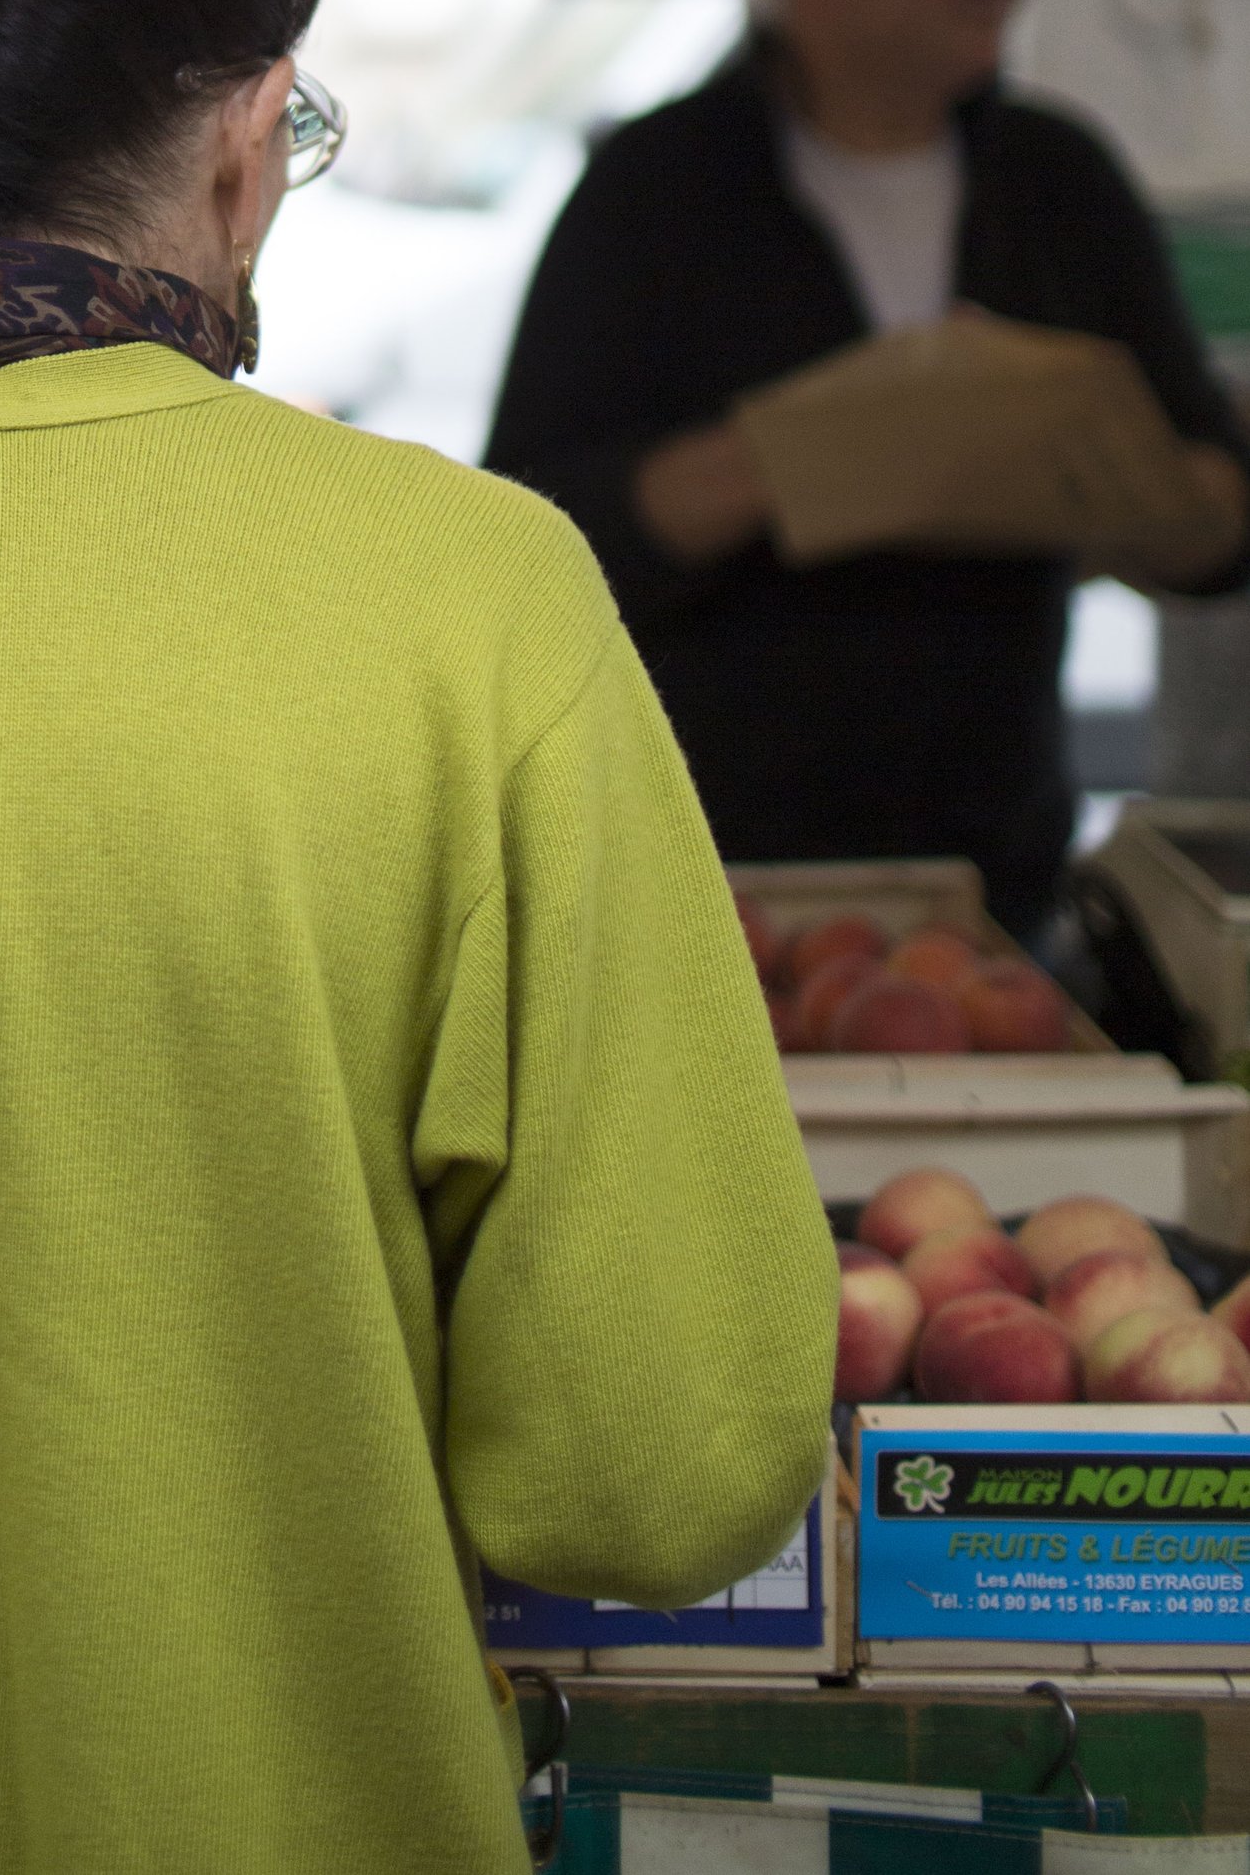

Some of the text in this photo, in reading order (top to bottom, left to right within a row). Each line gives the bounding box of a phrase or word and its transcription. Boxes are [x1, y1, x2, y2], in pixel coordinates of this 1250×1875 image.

[948, 1532, 1067, 1561] FRUITS
[1078, 1537, 1100, 1561] &
[976, 1571, 1009, 1588] Les
[1012, 1572, 1068, 1589] Allées
[1085, 1574, 1135, 1591] 13630
[1140, 1574, 1244, 1591] EYRAGUES
[978, 1593, 1000, 1610] 04
[1117, 1597, 1151, 1612] Fax
[1166, 1597, 1188, 1613] 04
